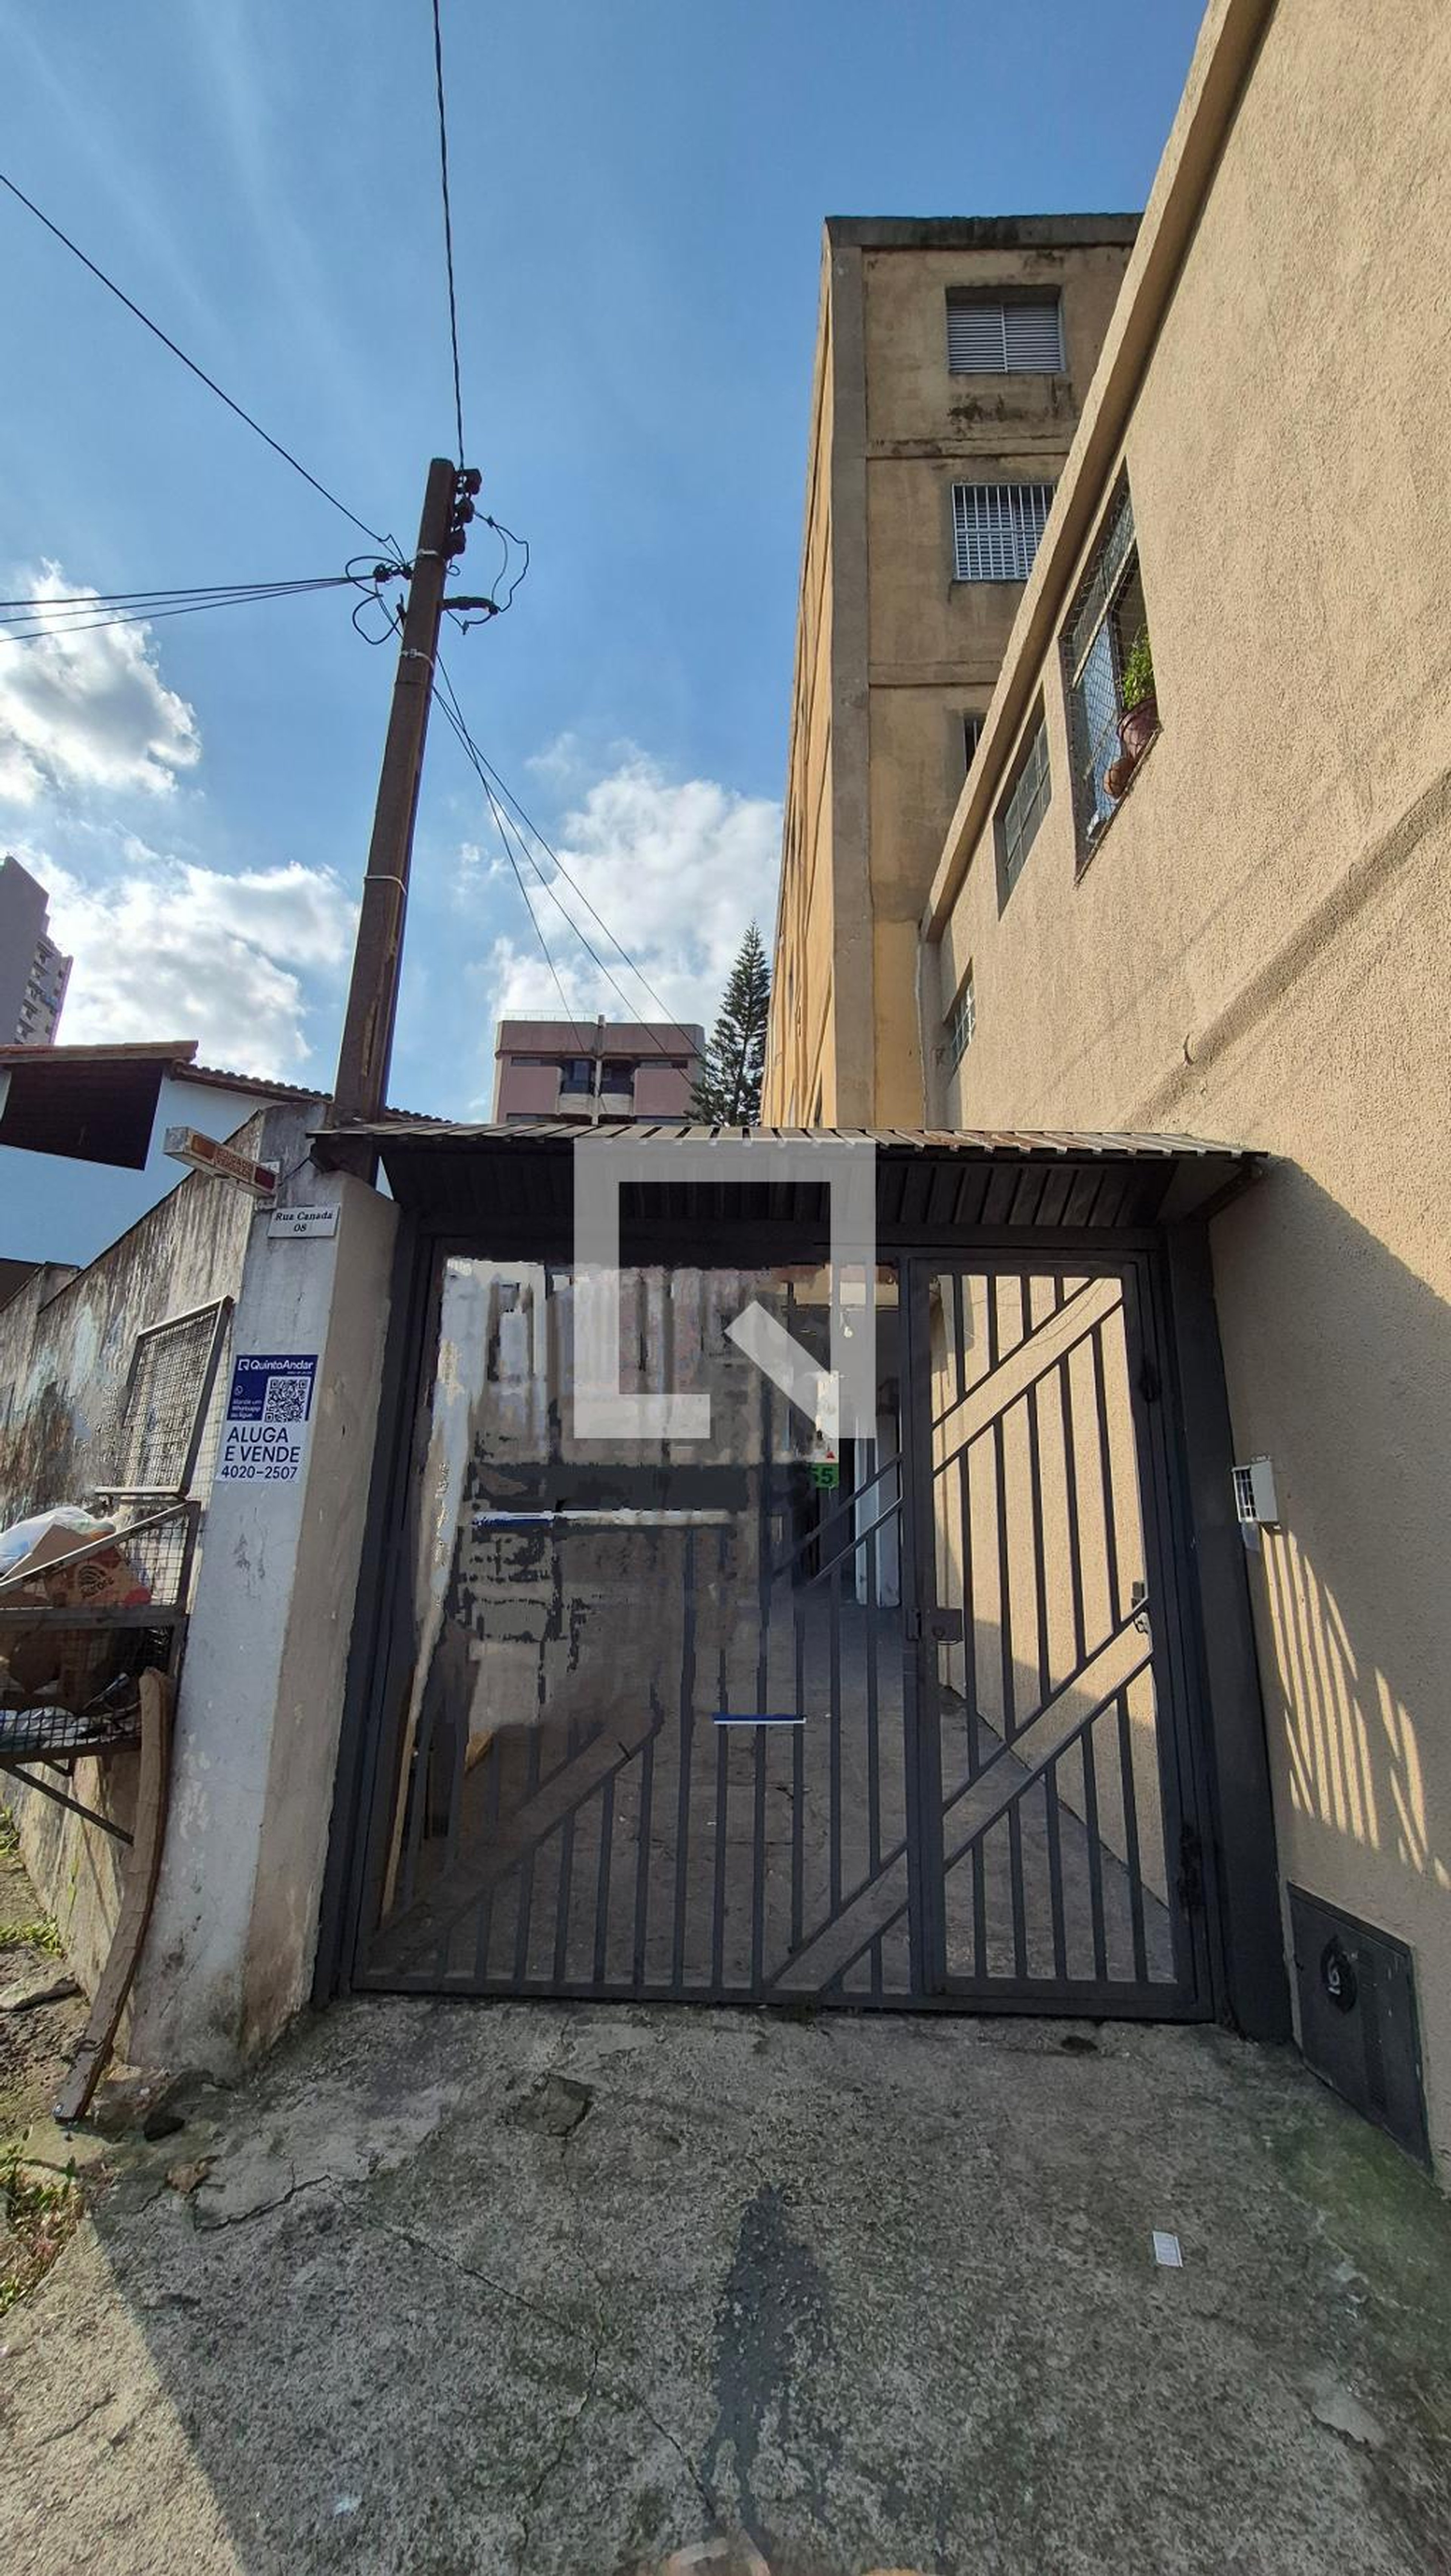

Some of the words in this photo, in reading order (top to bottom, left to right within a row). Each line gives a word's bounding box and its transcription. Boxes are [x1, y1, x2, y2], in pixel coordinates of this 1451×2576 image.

[297, 1211, 333, 1220] Canada
[251, 1360, 314, 1370] QuintoAndar
[227, 1427, 288, 1443] ALUGA
[224, 1446, 236, 1461] E
[240, 1446, 301, 1463] VENDE
[221, 1465, 298, 1480] 4020-2507
